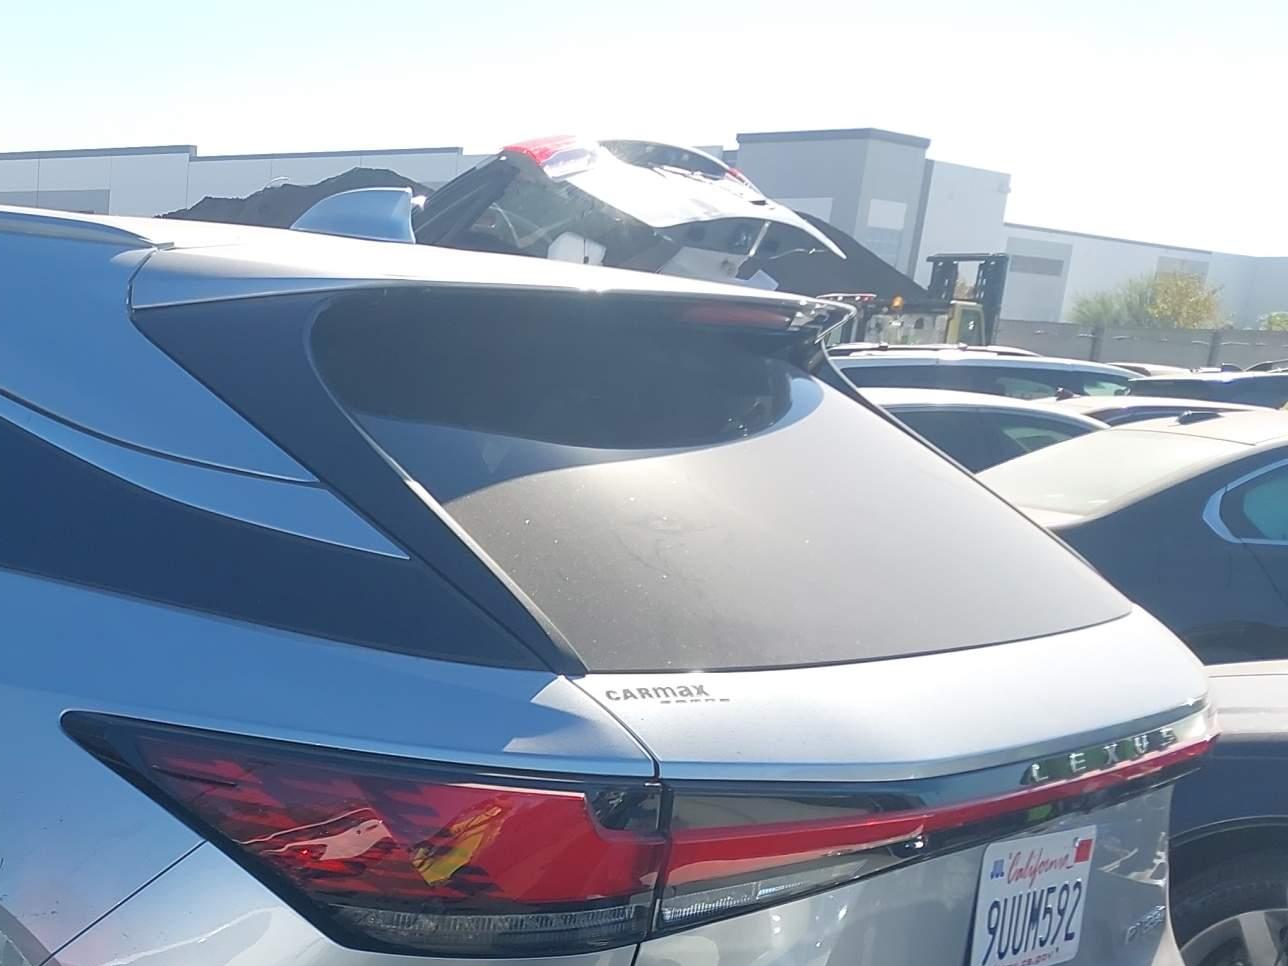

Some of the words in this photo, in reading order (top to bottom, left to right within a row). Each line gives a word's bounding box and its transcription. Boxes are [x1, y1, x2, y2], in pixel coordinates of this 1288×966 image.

[1030, 727, 1178, 783] LEXUS
[1007, 848, 1075, 888] California
[981, 880, 1083, 966] 9UUM592
